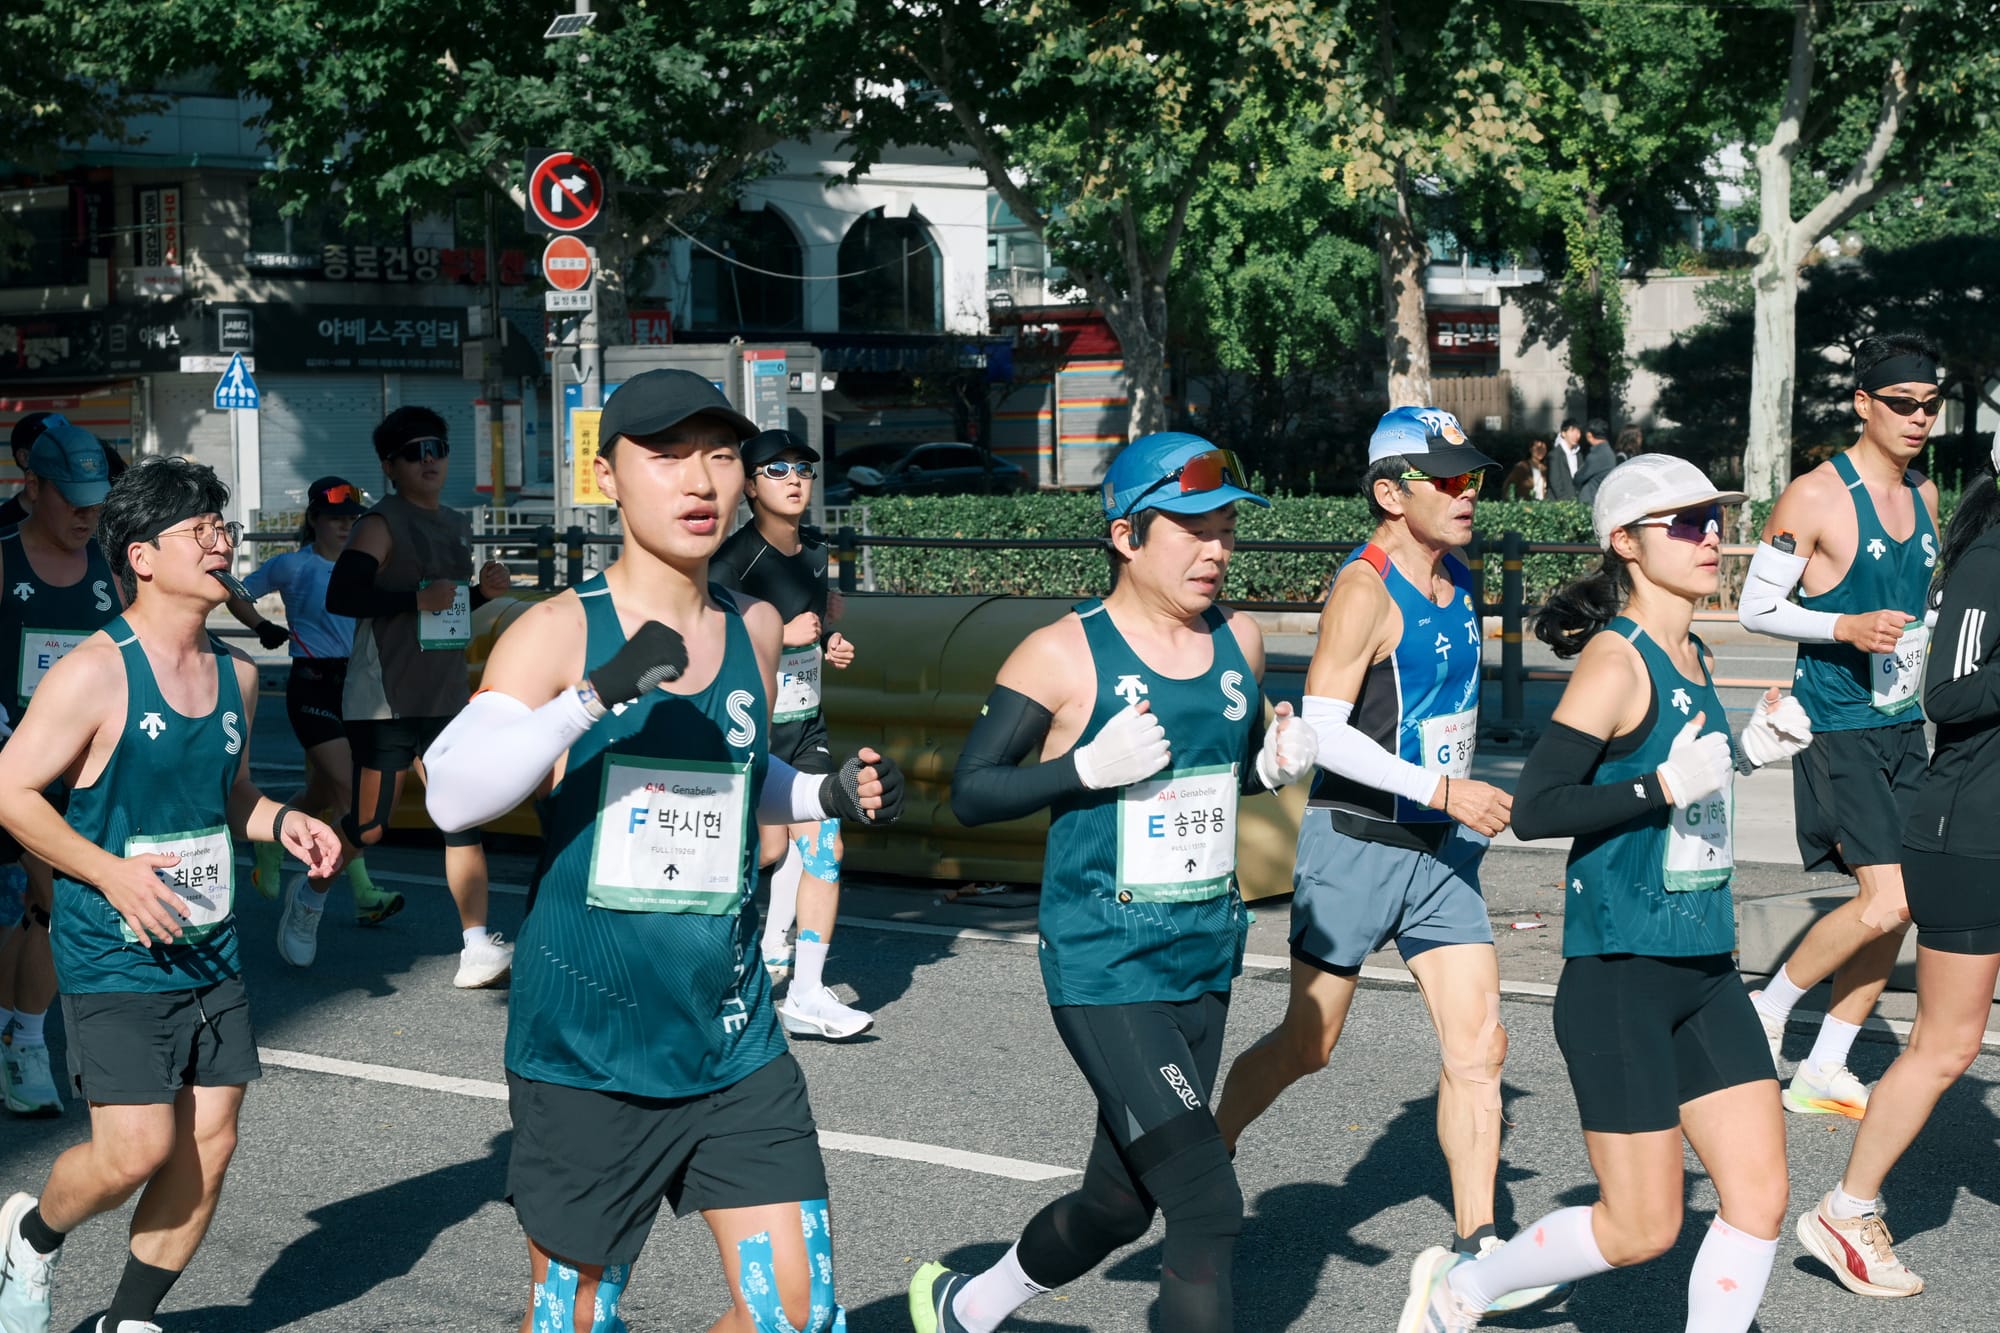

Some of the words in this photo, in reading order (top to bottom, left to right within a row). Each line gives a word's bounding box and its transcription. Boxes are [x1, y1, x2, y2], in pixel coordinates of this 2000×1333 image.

[323, 244, 439, 281] 종로건양
[224, 320, 247, 331] JABEZ
[318, 317, 459, 347] 야베스주얼리
[224, 331, 249, 342] Jewelry
[45, 640, 60, 648] AIA
[38, 654, 50, 670] E
[1883, 658, 1892, 674] G
[783, 673, 793, 687] F
[726, 690, 757, 748] S
[1444, 724, 1458, 734] AIA
[1437, 744, 1450, 764] G
[645, 782, 666, 793] AIA
[672, 784, 717, 796] Genabelle
[1158, 790, 1177, 801] AIA
[1180, 787, 1217, 799] Genabelle
[1148, 815, 1166, 838] E
[1174, 807, 1225, 837] 송광용
[1686, 803, 1700, 826] G
[628, 807, 649, 834] F
[658, 808, 722, 839] 박시현
[180, 847, 211, 858] Genabelle
[173, 863, 219, 889] 최윤혁
[1159, 1063, 1202, 1111] 2XU
